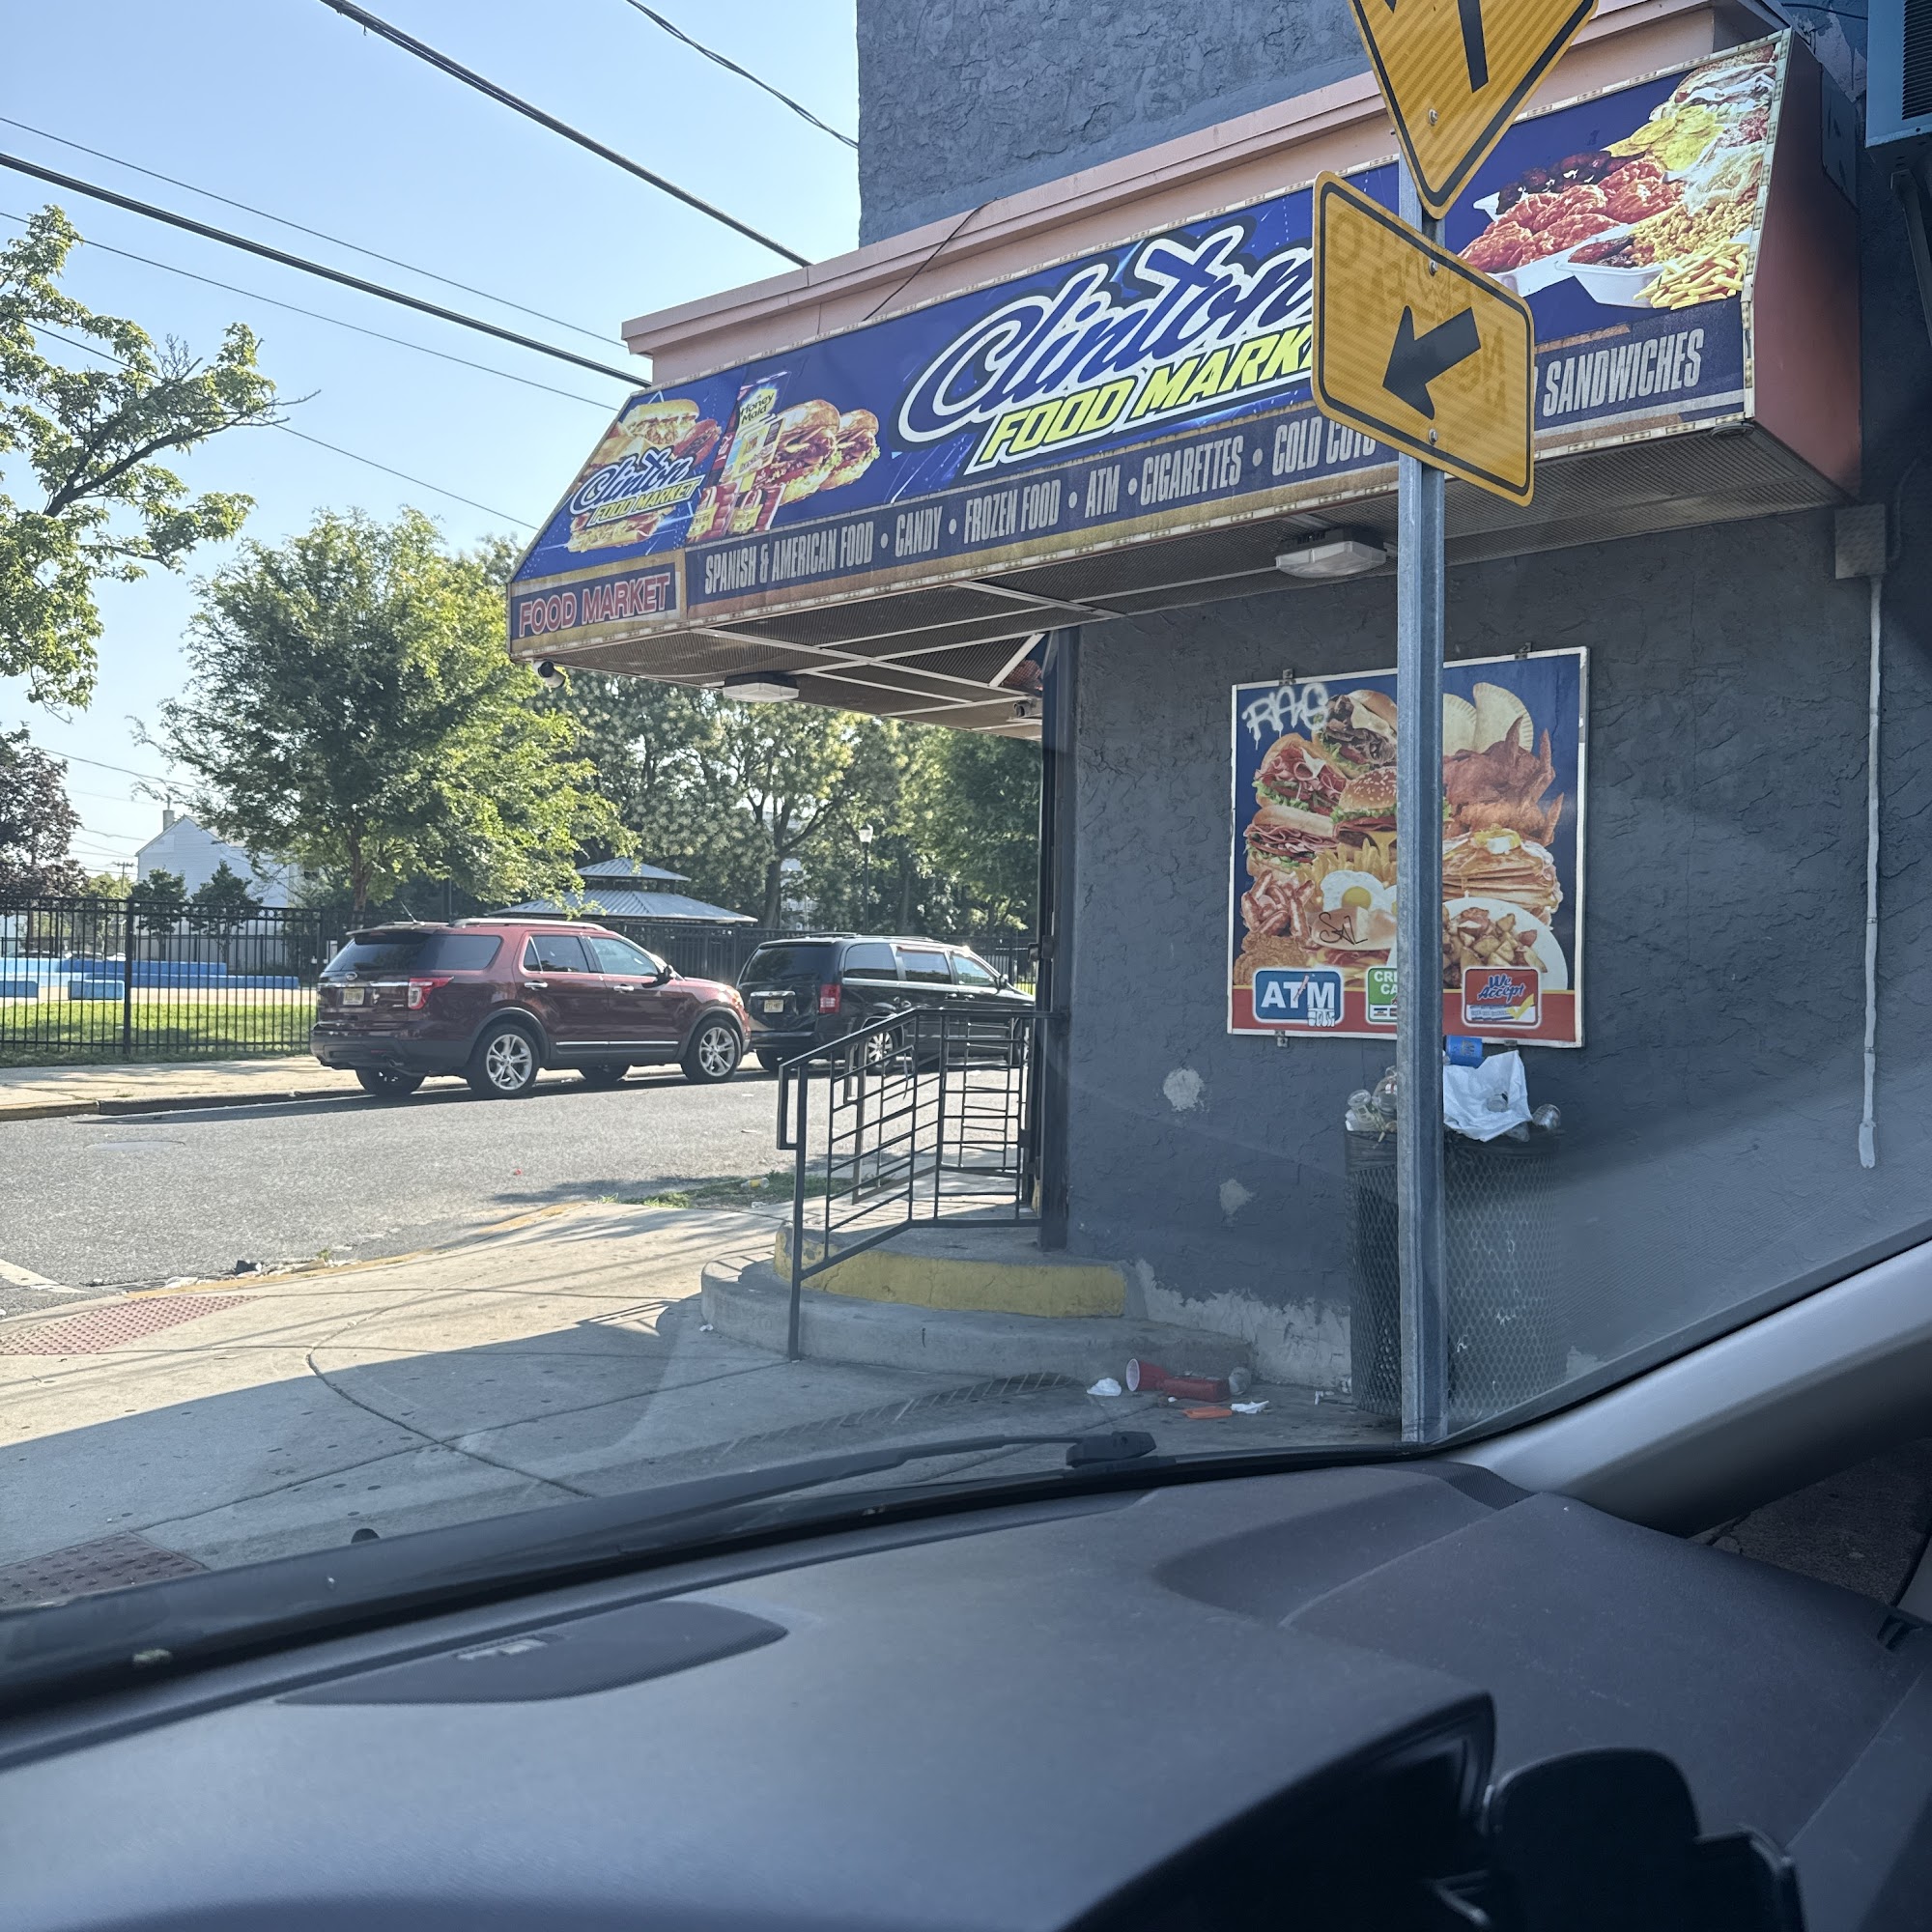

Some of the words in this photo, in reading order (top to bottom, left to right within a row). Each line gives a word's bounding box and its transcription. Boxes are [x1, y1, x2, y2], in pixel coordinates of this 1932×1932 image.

[898, 224, 1312, 442] Clinton
[740, 392, 775, 416] Honey
[979, 379, 1133, 463] FOOD
[1129, 323, 1312, 419] MARK
[741, 406, 768, 425] Maid
[569, 446, 695, 515] Clinton
[704, 546, 757, 595] SPANISH
[759, 543, 770, 584] &
[772, 527, 838, 582] AMERICAN
[839, 521, 874, 568] FOOD
[895, 506, 943, 557] CANDY
[963, 490, 1017, 544] FROZEN
[1020, 480, 1062, 532] FOOD
[1084, 465, 1122, 519] ATM
[1140, 435, 1245, 506] CIGARETTES
[1272, 415, 1323, 476] COLD
[1543, 328, 1705, 417] SANDWICHES
[591, 497, 637, 523] FOOD
[632, 480, 700, 512] MARKET
[519, 592, 578, 638] FOOD
[582, 572, 671, 625] MARKET
[1261, 980, 1335, 1009] ATM
[1476, 983, 1526, 1005] Accept
[1488, 973, 1513, 989] We
